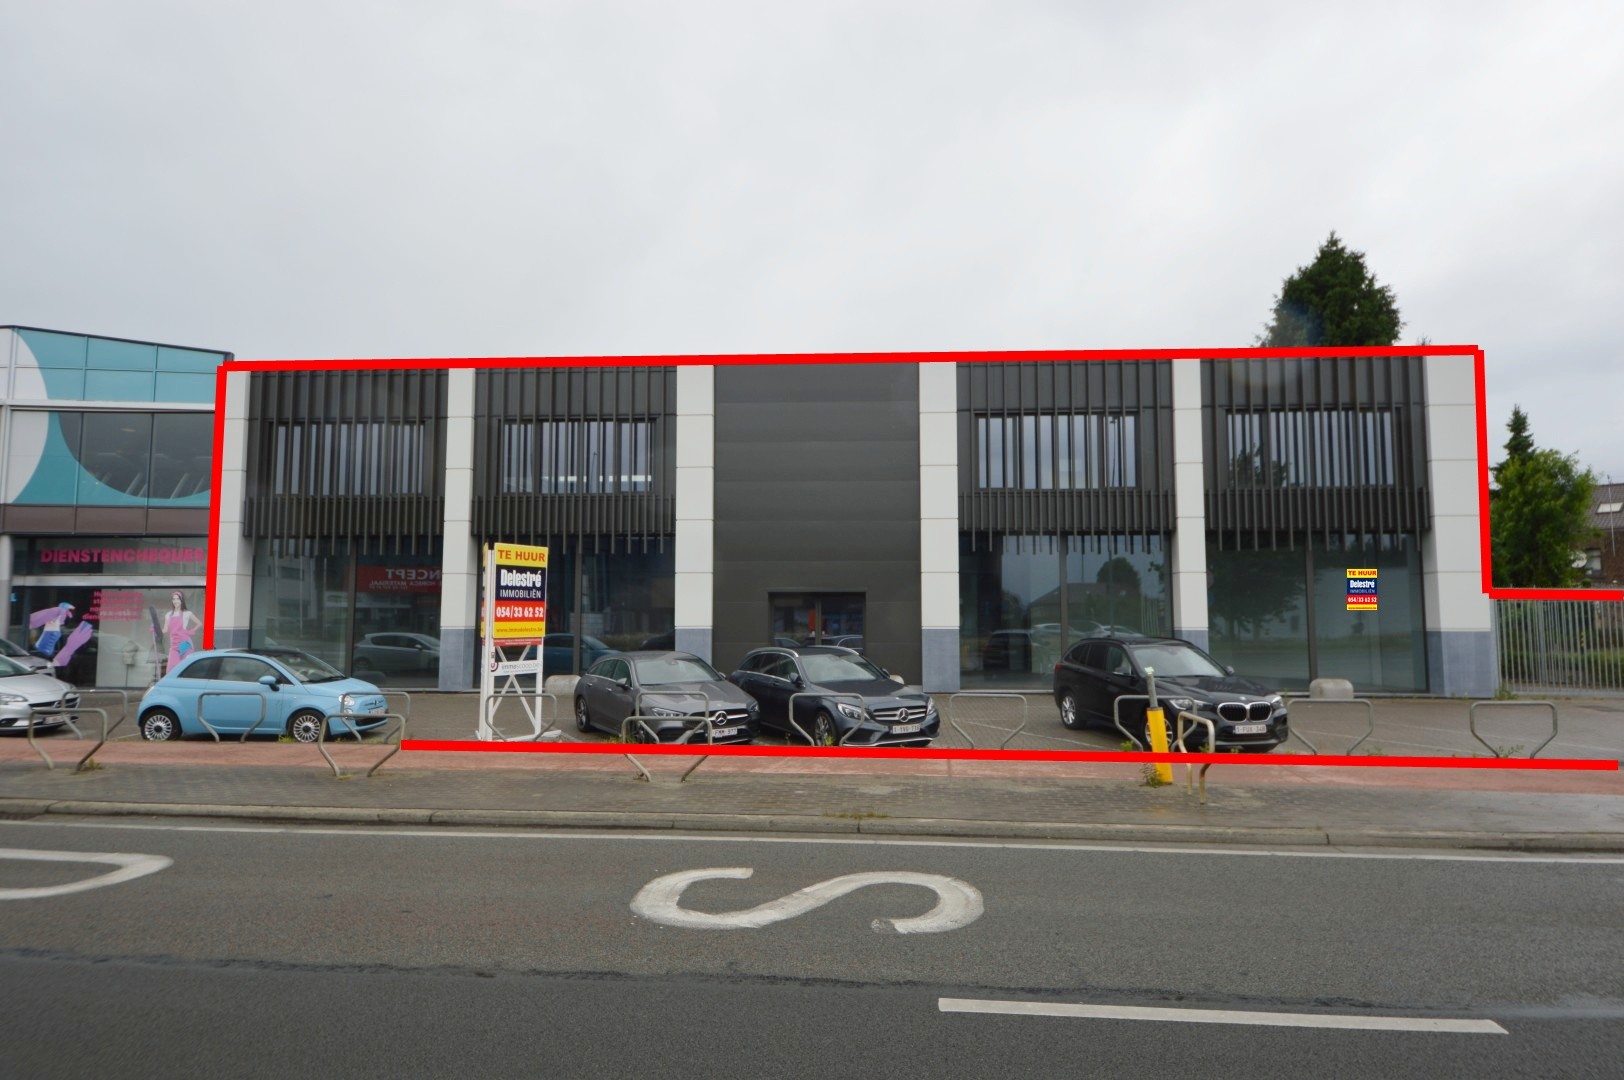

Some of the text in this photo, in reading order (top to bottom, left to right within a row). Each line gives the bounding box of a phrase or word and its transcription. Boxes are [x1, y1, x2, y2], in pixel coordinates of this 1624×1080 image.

[41, 549, 204, 564] DIENSTENCHEQUES
[498, 550, 545, 562] TE HUUR
[500, 568, 542, 587] Delestré
[1350, 580, 1375, 588] Delestré
[500, 588, 541, 599] IMMOBILIËN
[524, 606, 534, 618] 62
[535, 606, 544, 618] 52
